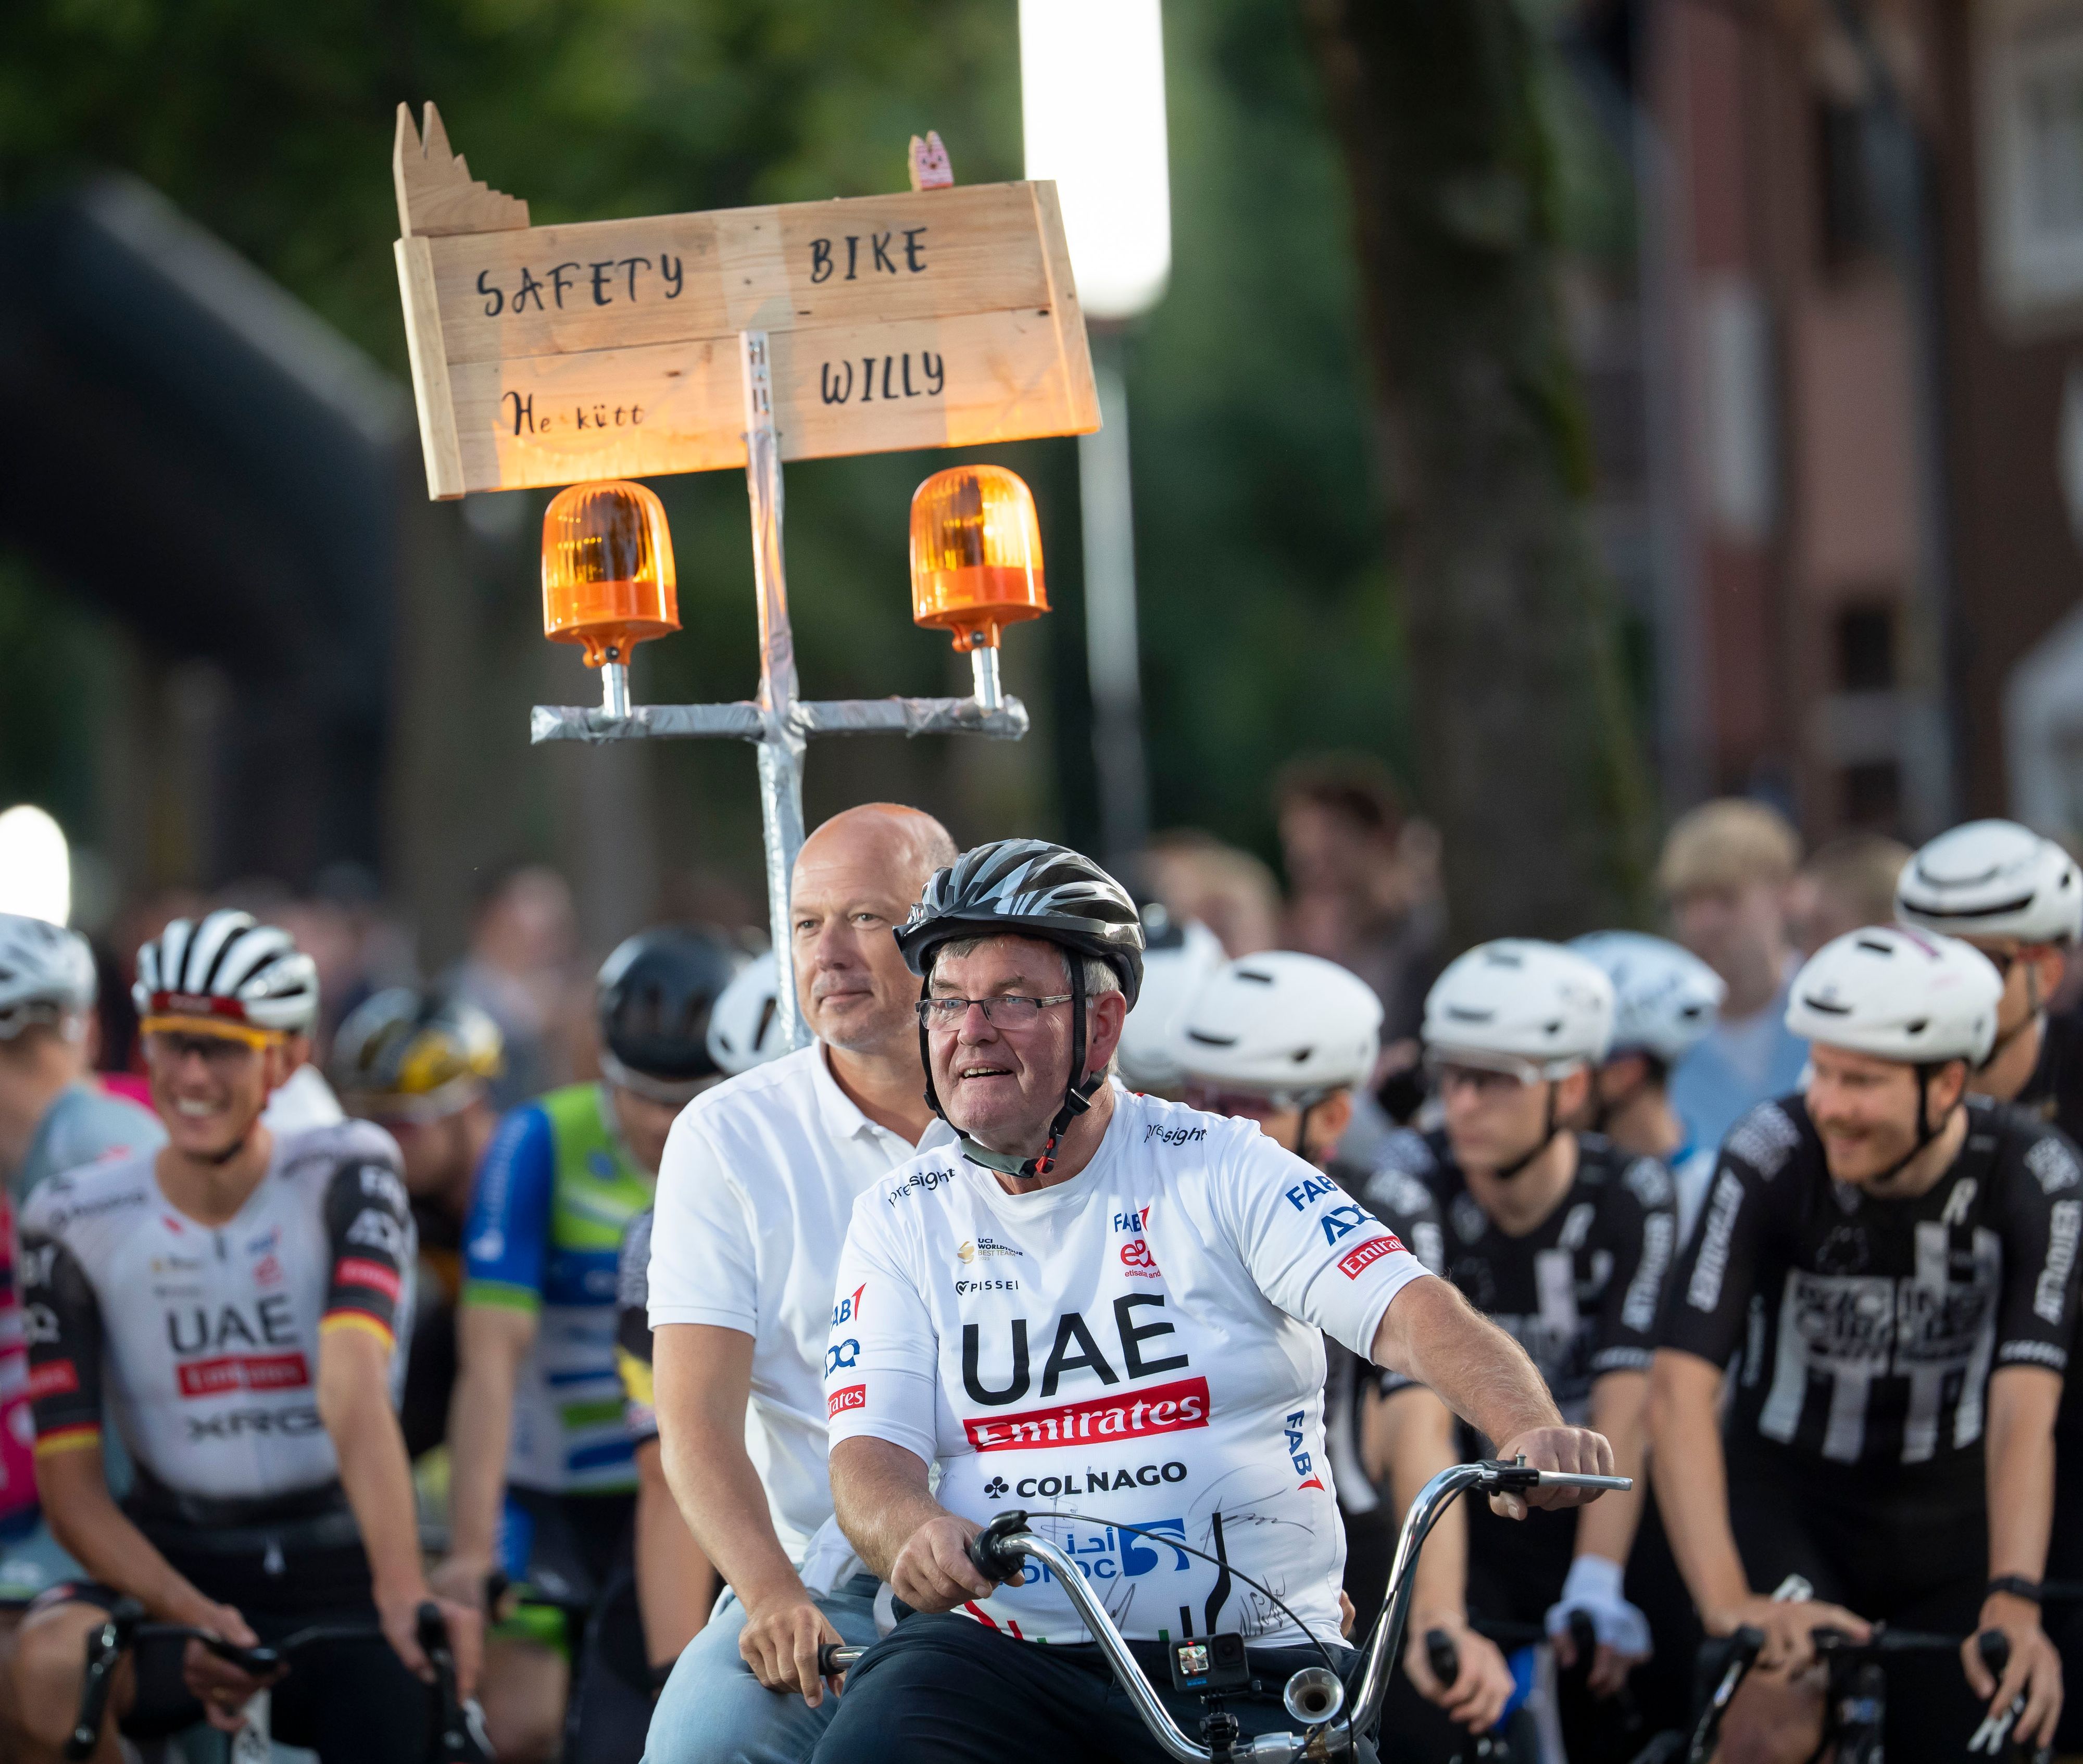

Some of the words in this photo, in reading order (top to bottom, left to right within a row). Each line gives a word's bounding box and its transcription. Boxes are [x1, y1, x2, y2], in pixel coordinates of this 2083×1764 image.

[476, 253, 683, 317] SAFETY
[809, 226, 927, 284] BIKE
[501, 391, 551, 436] He
[576, 404, 644, 429] kütt
[821, 350, 945, 406] WILLY
[888, 1168, 956, 1208] presight
[1285, 1175, 1338, 1212] FAB
[1114, 1212, 1142, 1232] FAB
[977, 1243, 1023, 1256] WORLDTOUR
[970, 1280, 1019, 1292] PISSEI
[1149, 1269, 1161, 1279] and
[165, 1294, 300, 1355] UAE
[831, 1299, 851, 1332] AB
[962, 1293, 1189, 1406] UAE
[972, 1396, 1201, 1446] Emirates
[1284, 1409, 1312, 1476] FAB
[1016, 1461, 1187, 1496] COLNAGO
